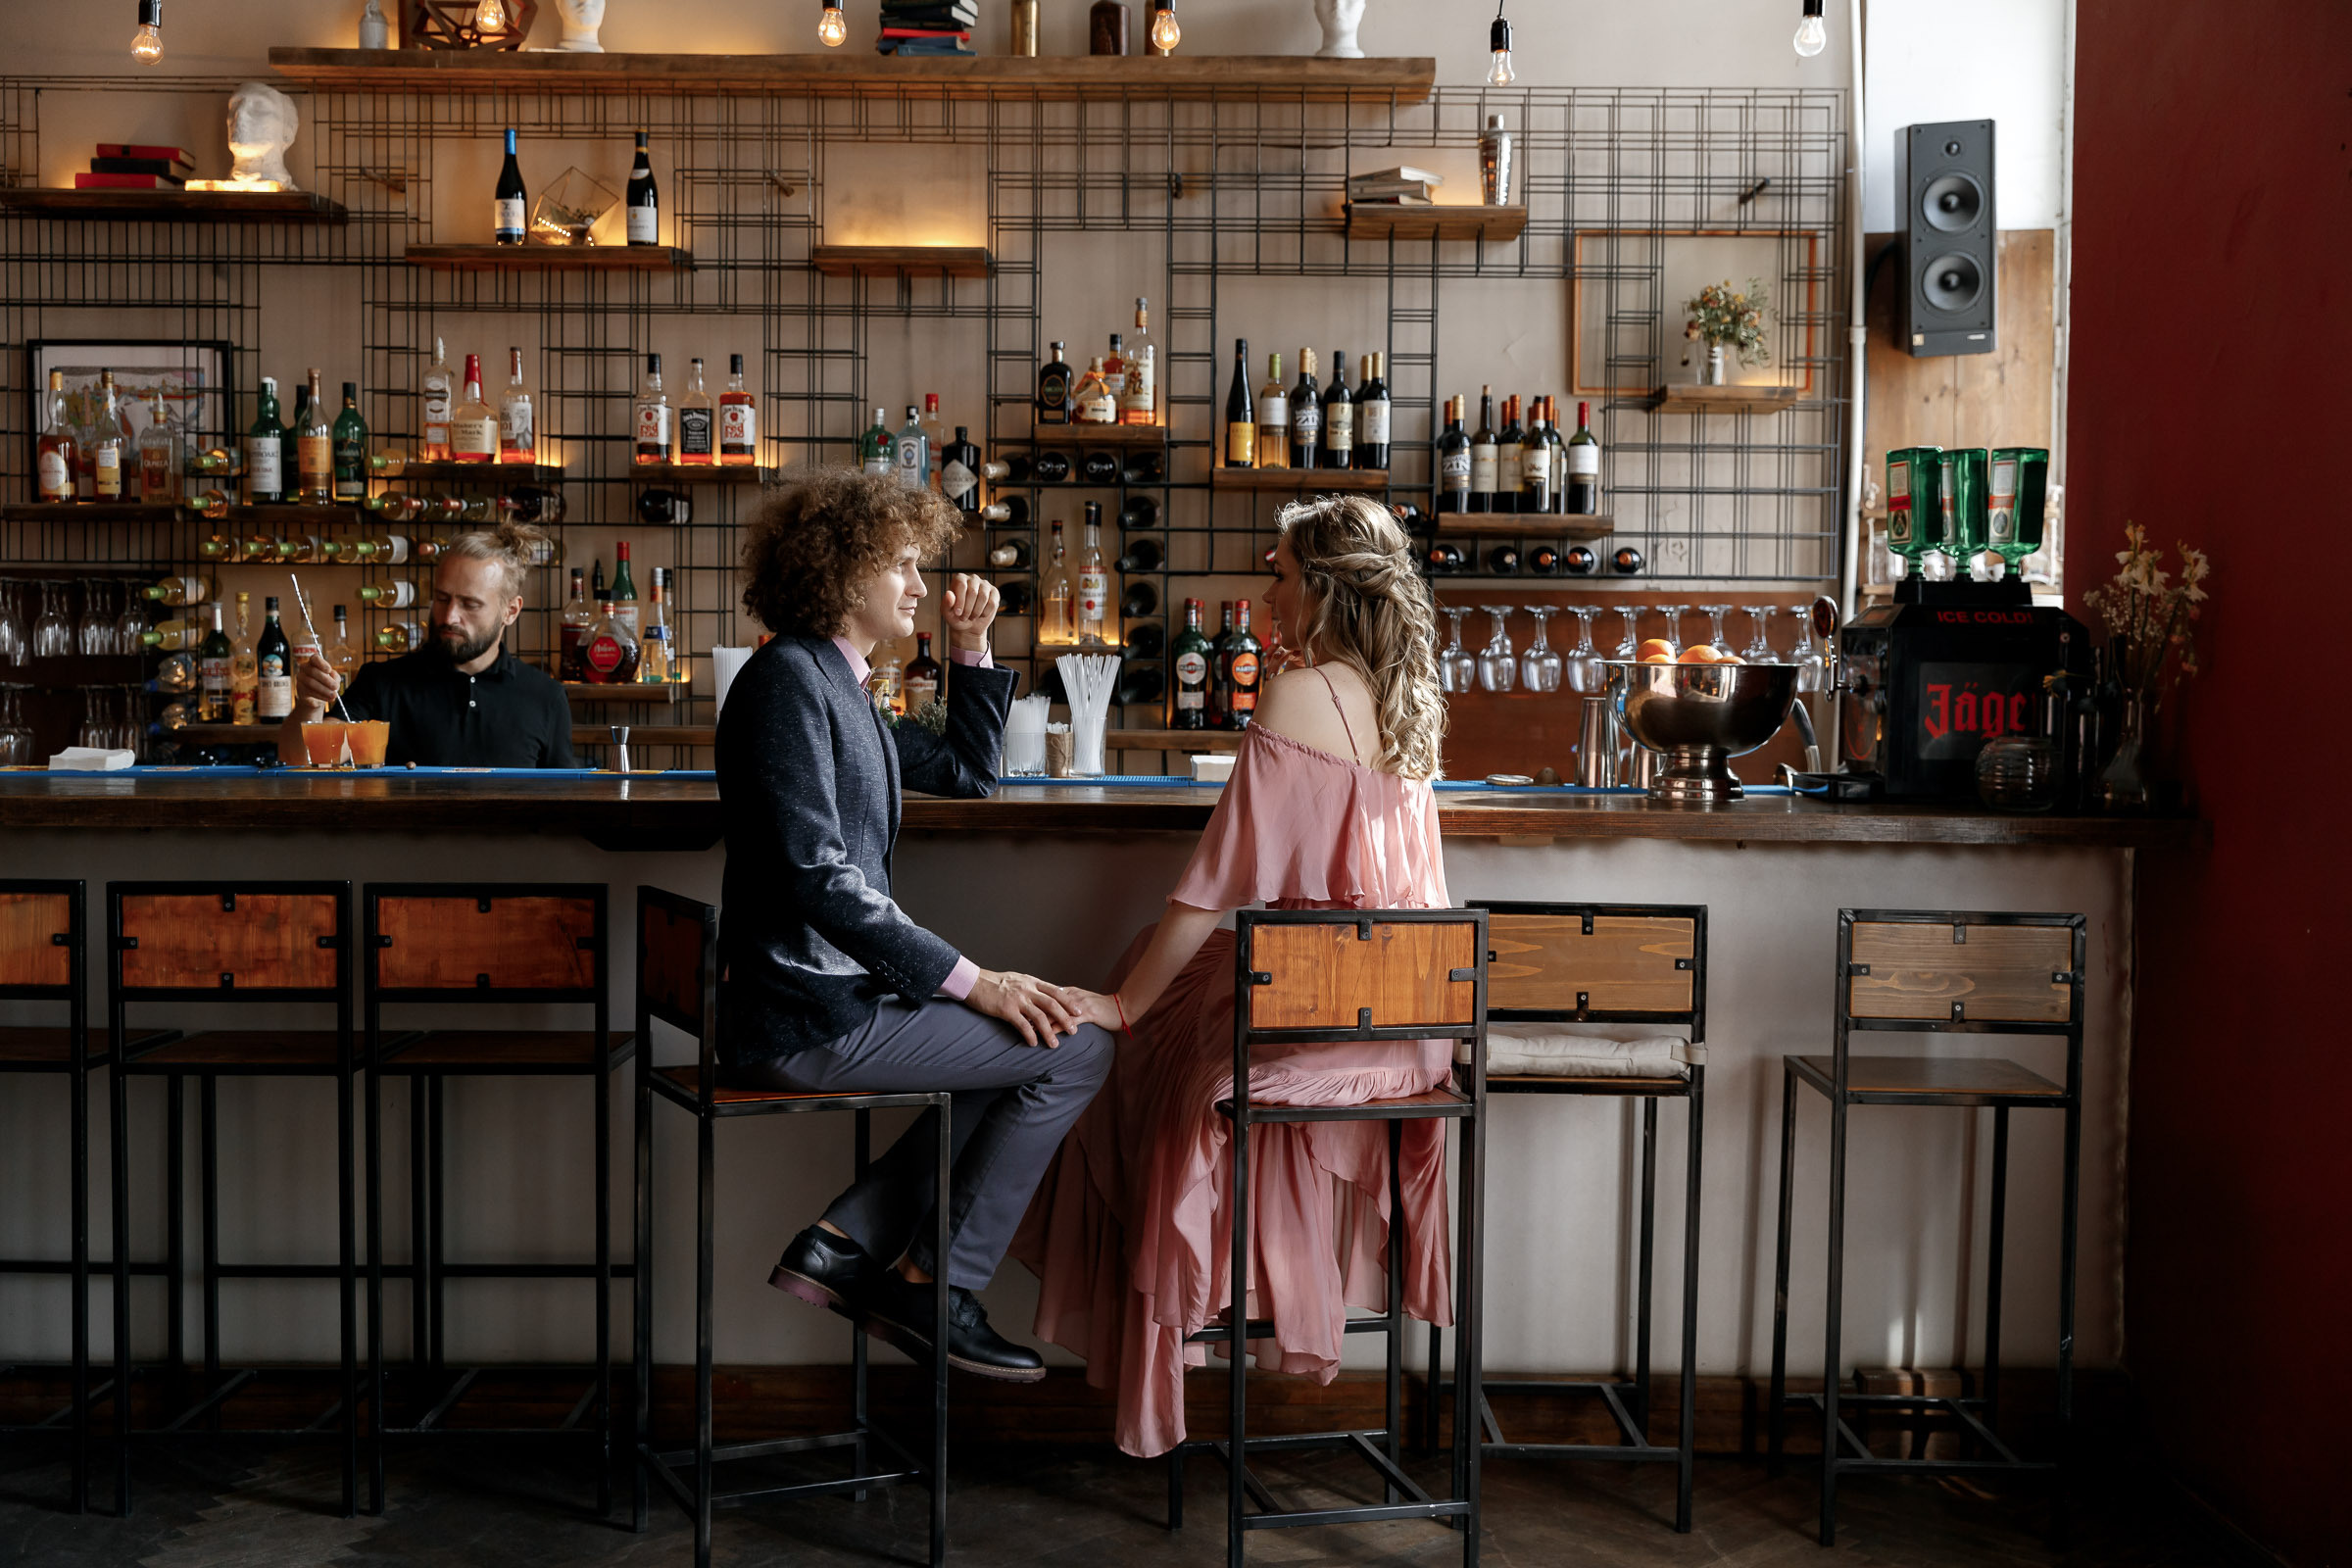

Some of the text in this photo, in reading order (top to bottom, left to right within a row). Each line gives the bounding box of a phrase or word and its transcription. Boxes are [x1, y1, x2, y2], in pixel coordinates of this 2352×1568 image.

[640, 422, 659, 432] red
[725, 422, 744, 432] red
[1443, 462, 1471, 472] ZIN
[1937, 611, 2034, 624] ICE COLD!
[1924, 682, 2037, 740] Jäge
